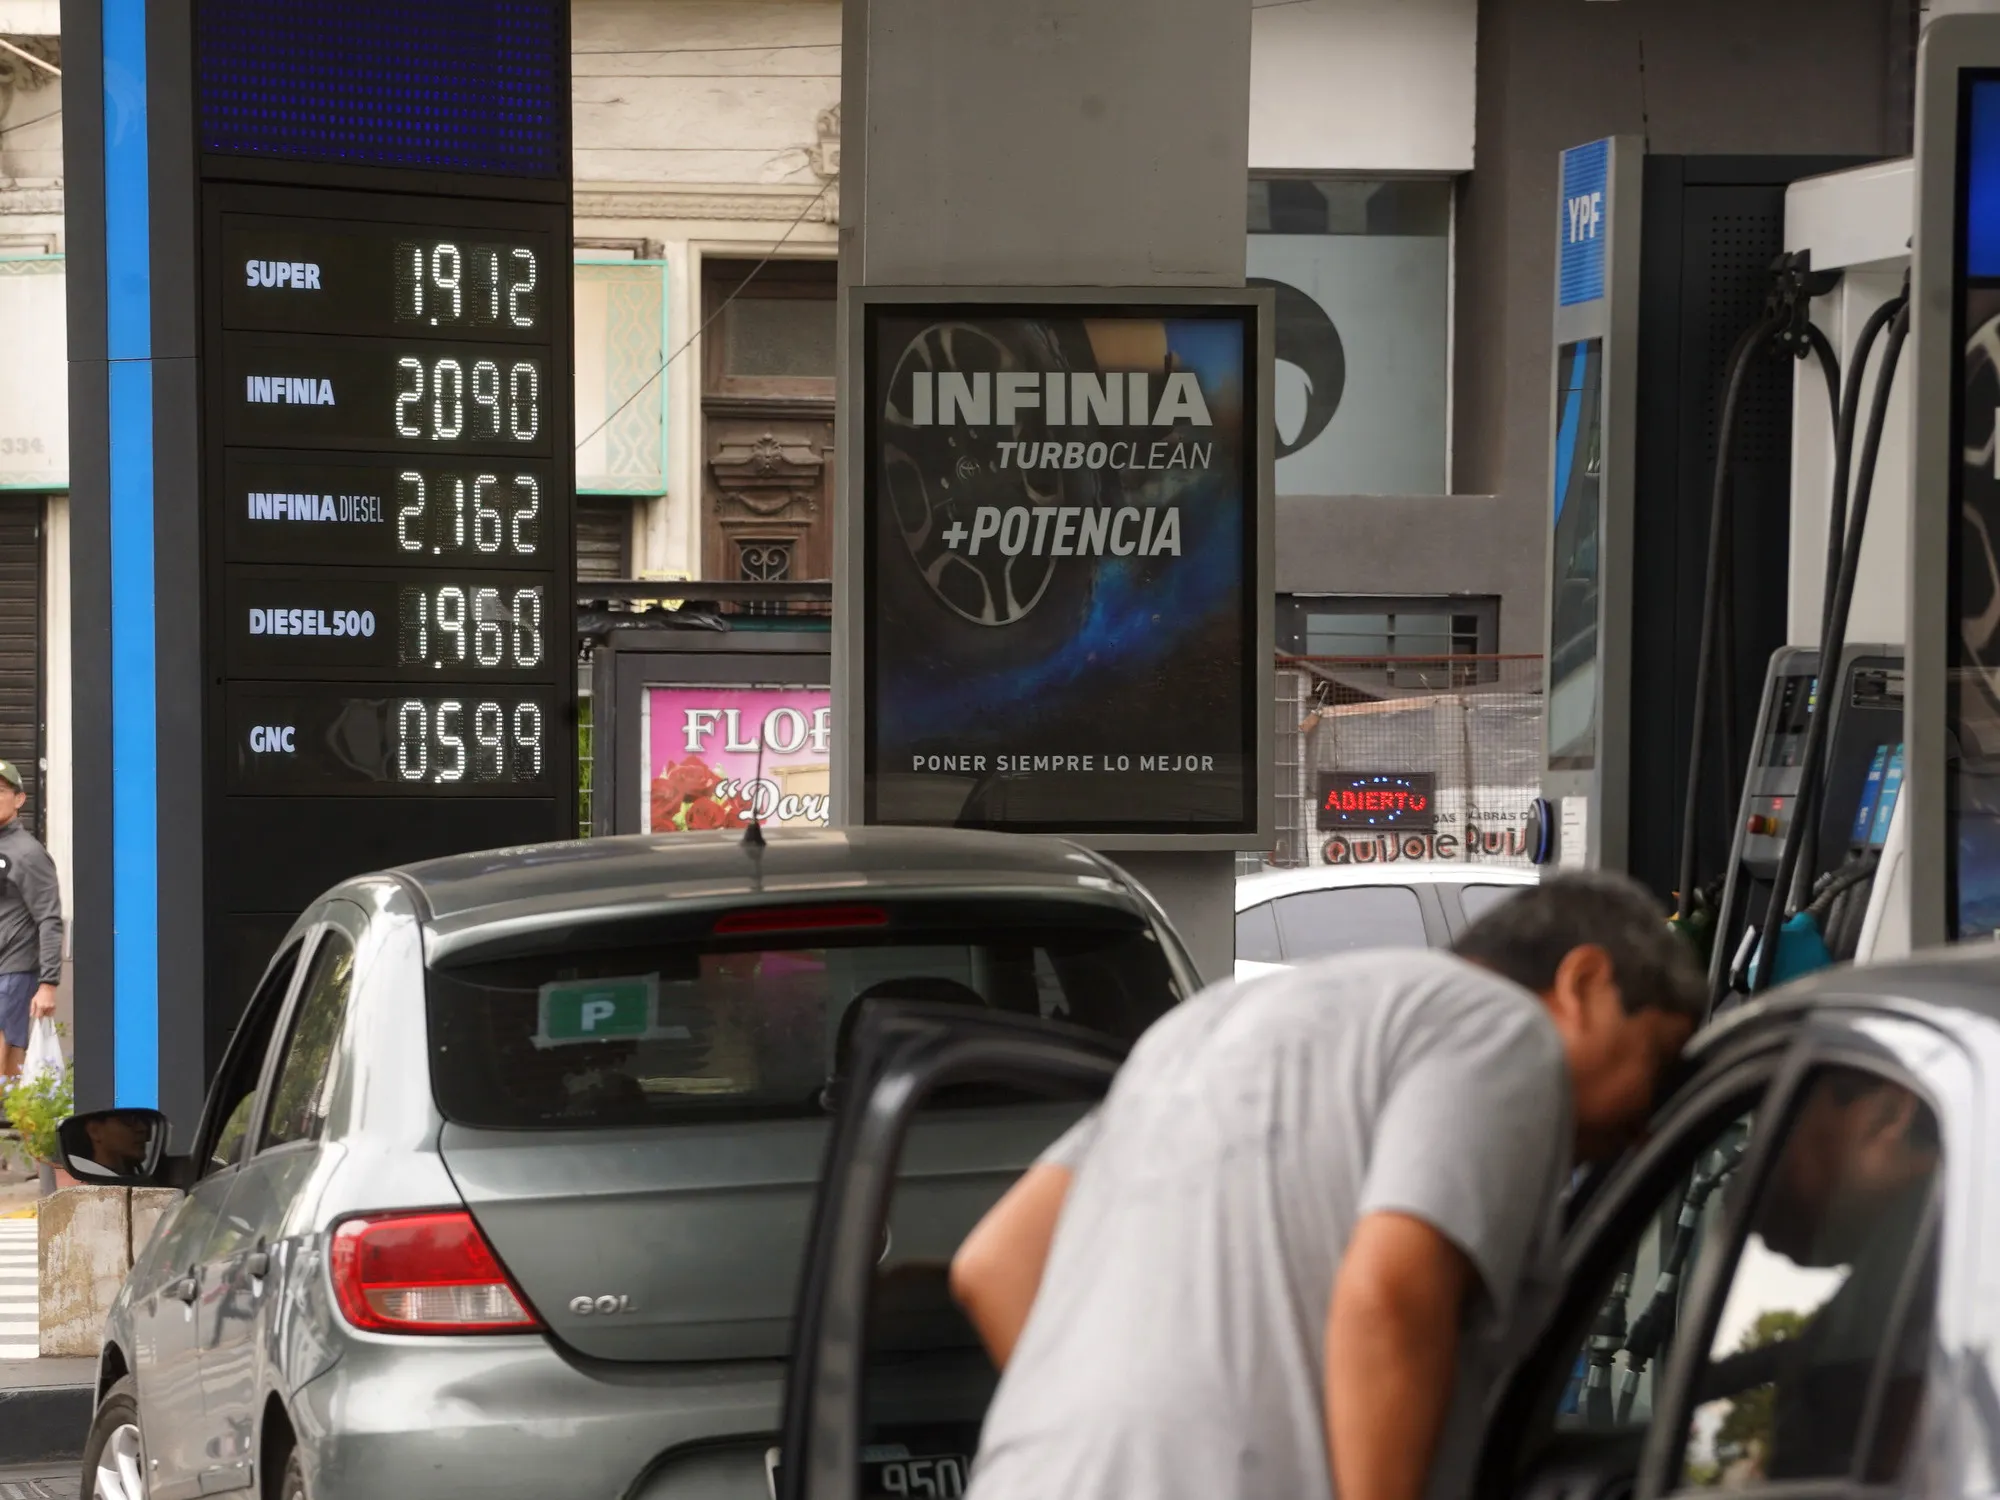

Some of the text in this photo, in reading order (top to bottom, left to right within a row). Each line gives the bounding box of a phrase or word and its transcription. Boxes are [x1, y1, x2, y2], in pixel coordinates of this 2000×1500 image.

[1568, 191, 1600, 243] YPF
[246, 259, 321, 290] SUPER
[246, 375, 336, 406] INFINIA
[912, 371, 1214, 426] INFINIA
[996, 441, 1213, 470] TURBOCLEAN
[247, 492, 338, 522] INFINIA
[339, 495, 384, 523] DIESEL
[941, 506, 1182, 557] +POTENCIA
[250, 725, 296, 753] GNC
[913, 755, 1215, 772] PONER SIEMPRE LO MEJOR
[581, 1000, 616, 1031] P
[569, 1294, 639, 1315] GOL
[882, 1459, 962, 1500] 950
